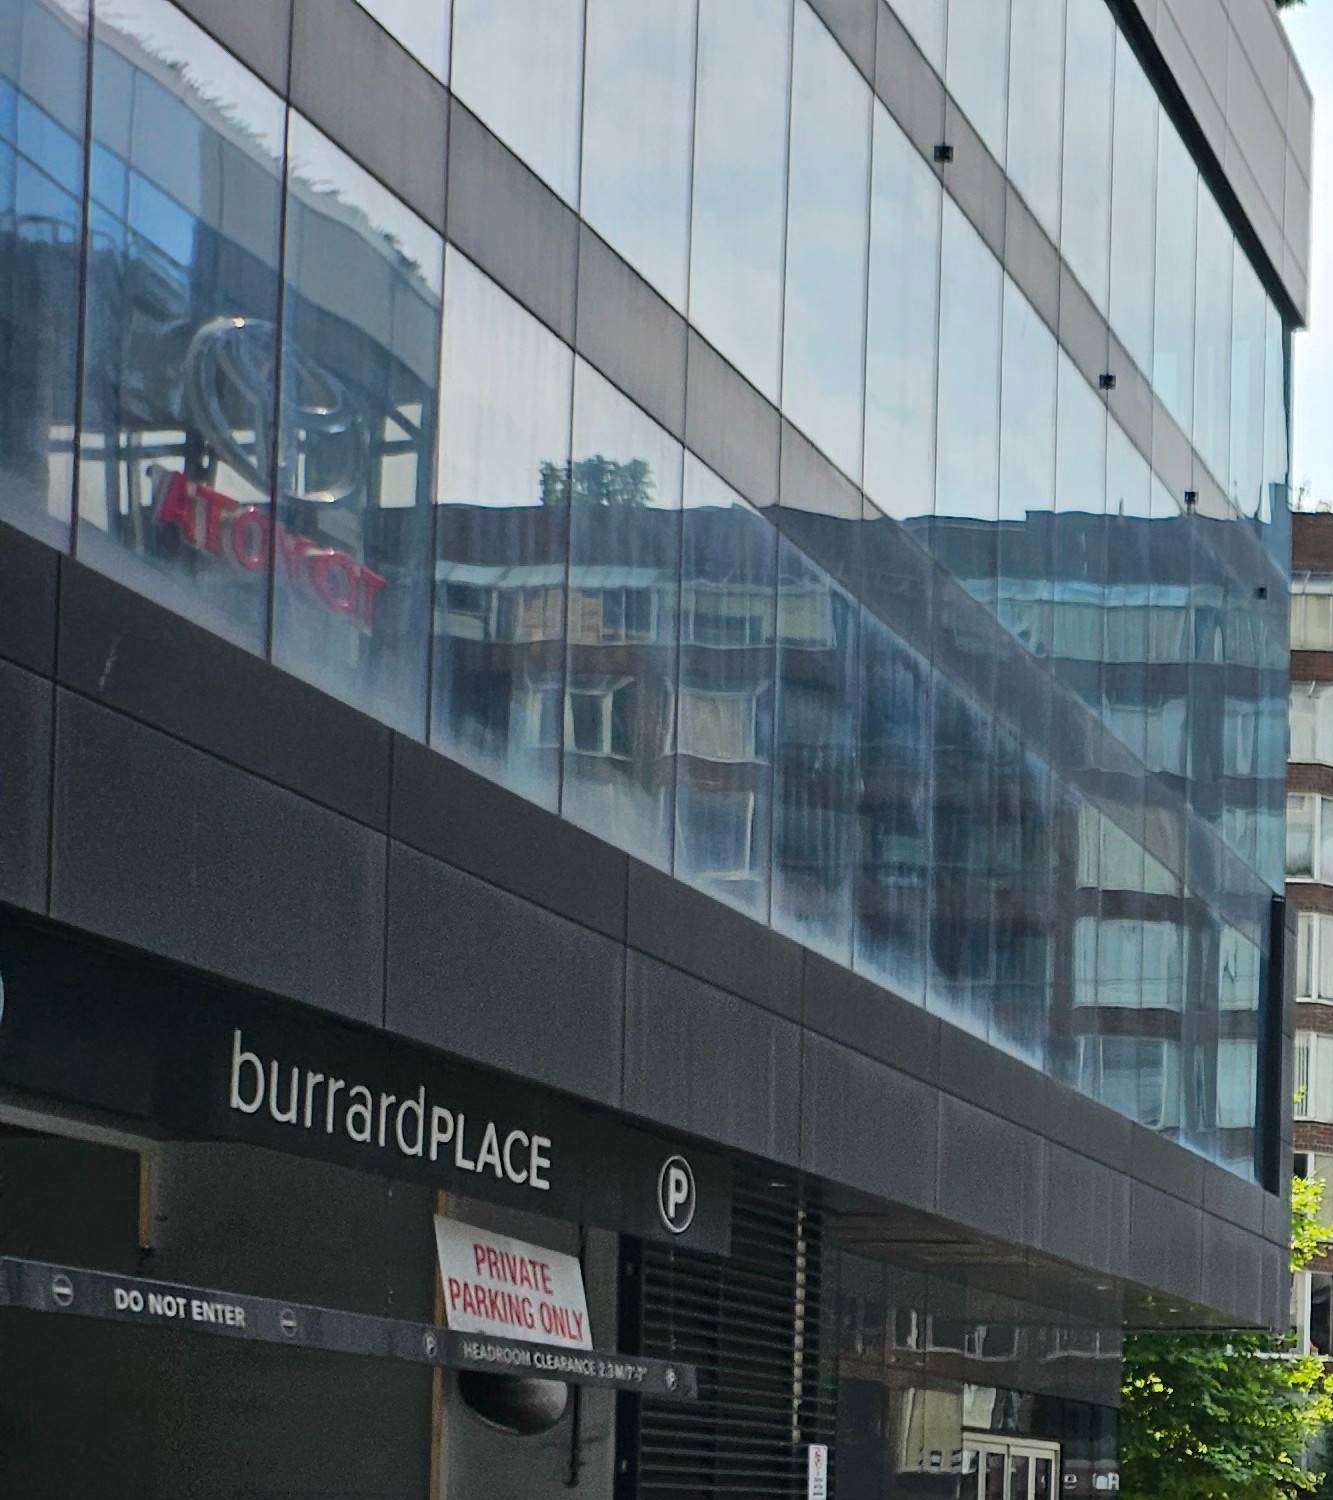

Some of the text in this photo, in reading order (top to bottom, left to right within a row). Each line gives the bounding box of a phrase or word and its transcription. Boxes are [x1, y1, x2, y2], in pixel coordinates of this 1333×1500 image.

[229, 1028, 552, 1191] burrardPLACE
[473, 1243, 553, 1296] PRIVATE
[113, 1287, 247, 1328] DO NOT ENTER
[448, 1278, 584, 1341] PARKING ONLY
[462, 1341, 531, 1367] HEADROOM
[533, 1351, 597, 1377] CLEARANCE
